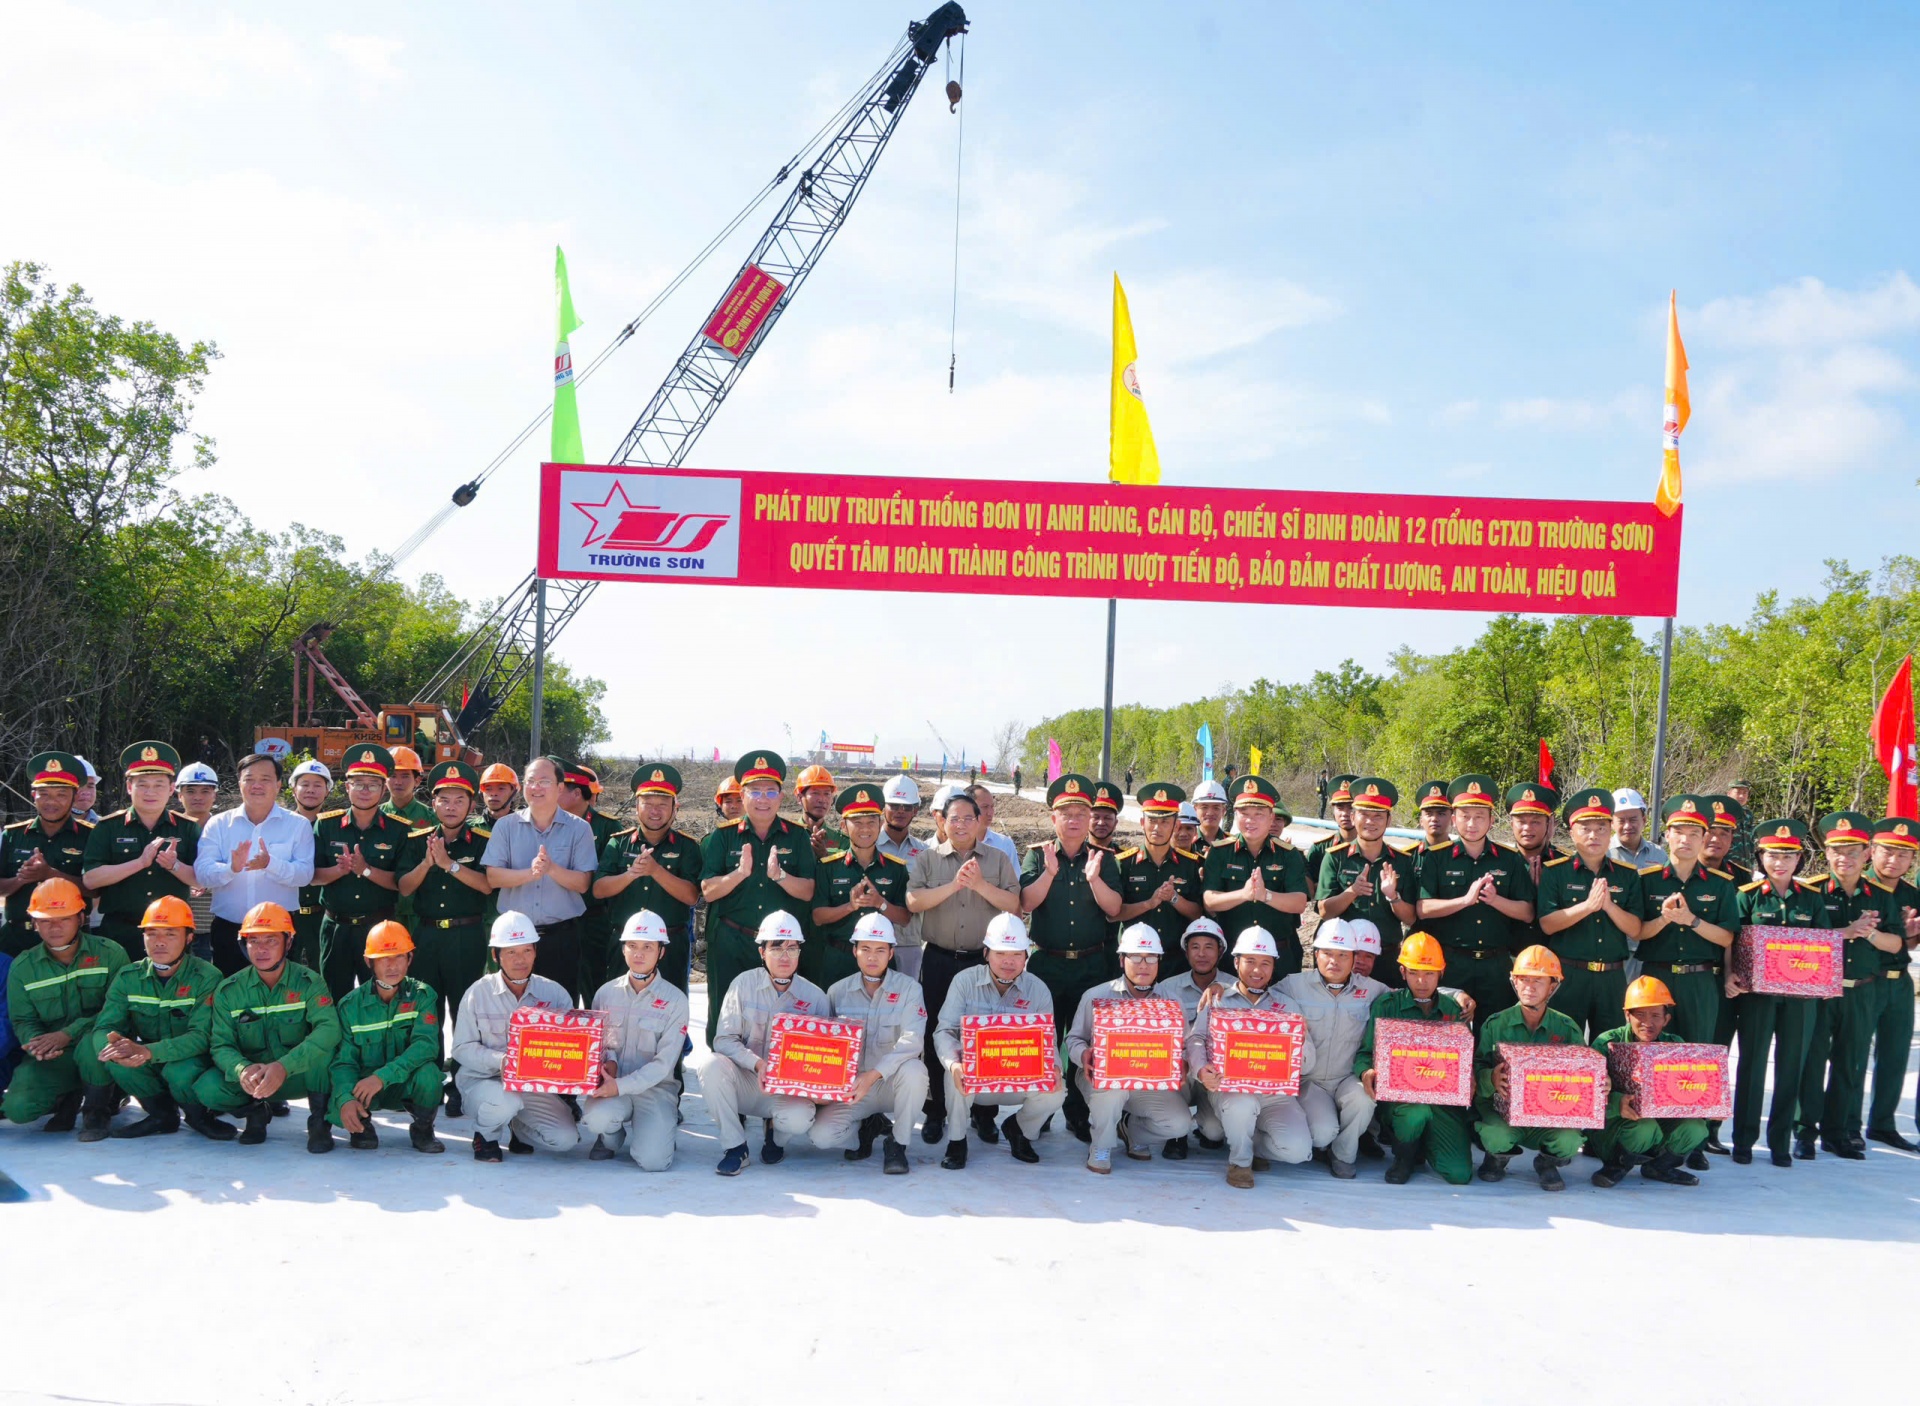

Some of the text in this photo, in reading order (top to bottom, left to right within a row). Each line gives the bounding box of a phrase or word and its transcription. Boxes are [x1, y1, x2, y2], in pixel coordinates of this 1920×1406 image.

[744, 308, 755, 318] TY
[755, 489, 1654, 554] PHÁT HUY TRUYỀN THỐNG ĐƠN VỊ ANH HÙNG, CÁN BỘ, CHIẾN SĨ BINH ĐOÀN 12 (TỔNG CTXD TRƯỜNG SƠN)
[588, 551, 704, 570] TRƯỜNG SƠN
[790, 536, 1616, 601] QUYẾT TÂM HOÀN THÀNH CÔNG TRÌNH VƯỢT TIẾN ĐỘ, BẢO ĐẢM CHẤT LƯỢNG, AN TOÀN, HIỆU QUẢ
[524, 1048, 583, 1060] PHẠM MINH CHÍNH
[786, 1051, 842, 1065] PHẠM MINH CHÍNH
[982, 1045, 1038, 1058] PHẠM MINH CHÍNH
[1111, 1050, 1129, 1059] PHẠM
[1149, 1048, 1167, 1058] CHÍNH
[1230, 1049, 1286, 1060] PHẠM MINH CHÍNH
